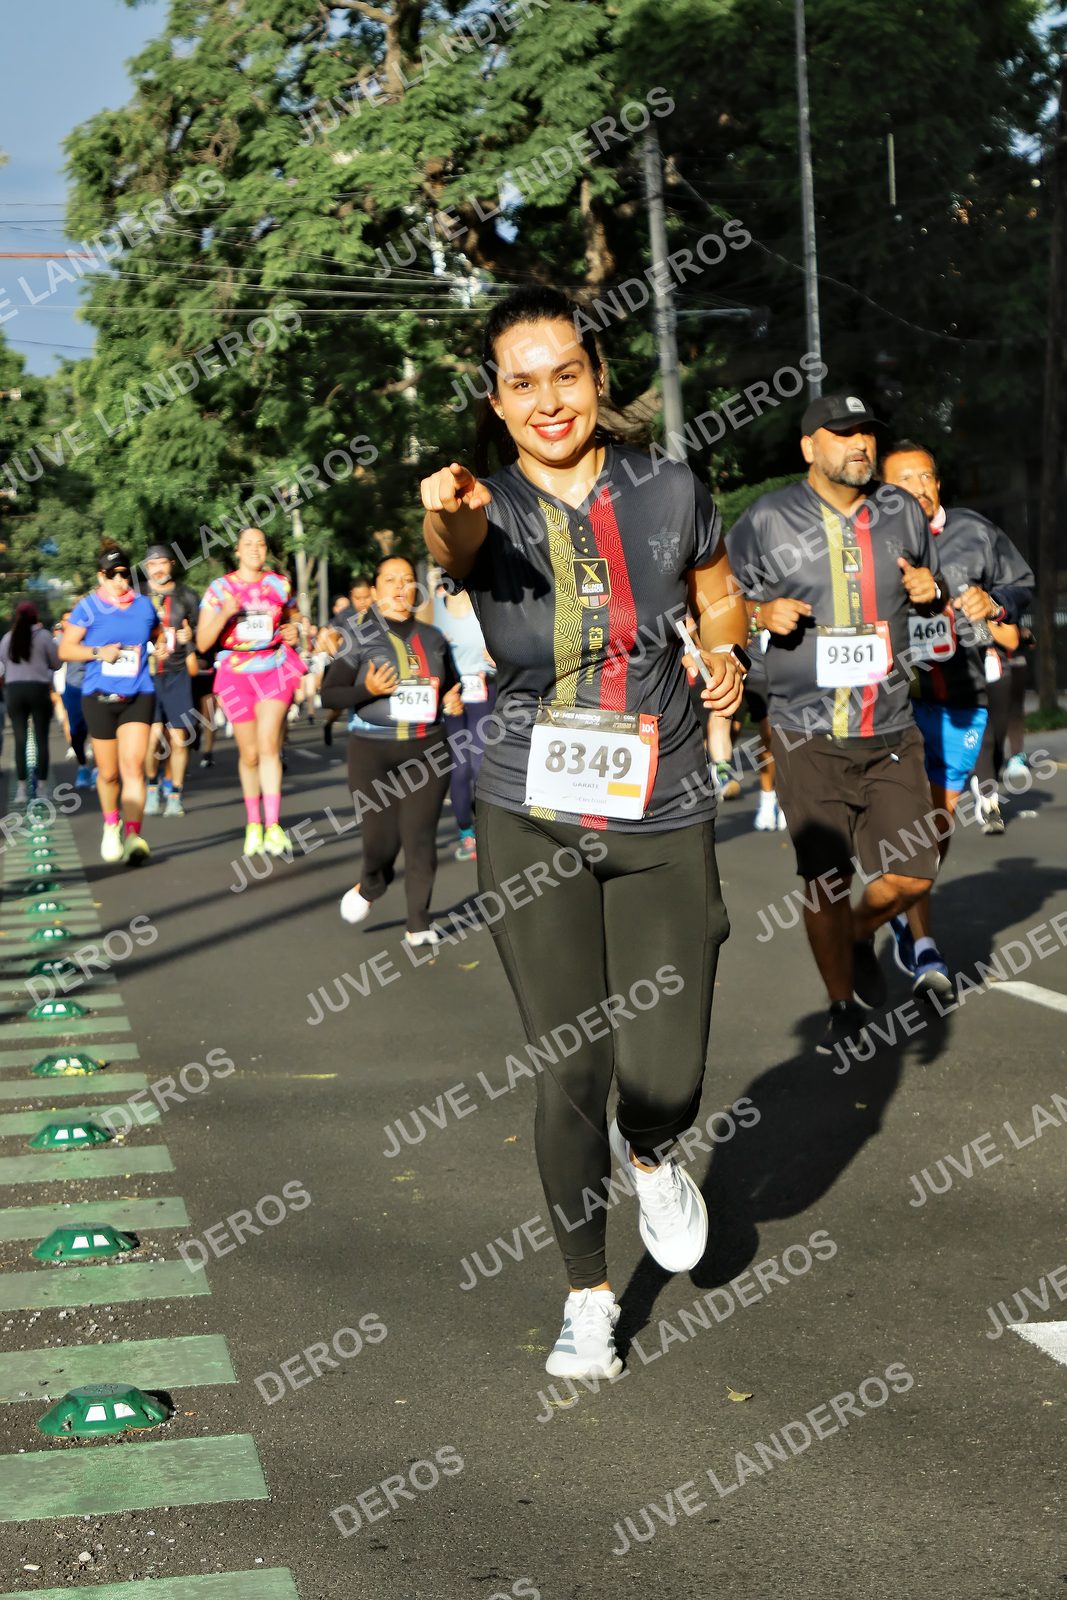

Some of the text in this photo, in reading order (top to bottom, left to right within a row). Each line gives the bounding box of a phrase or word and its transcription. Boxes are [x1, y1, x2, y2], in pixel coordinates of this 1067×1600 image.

[914, 620, 946, 640] 460
[828, 644, 874, 664] 9361
[399, 691, 430, 705] 9674
[545, 740, 632, 780] 8349
